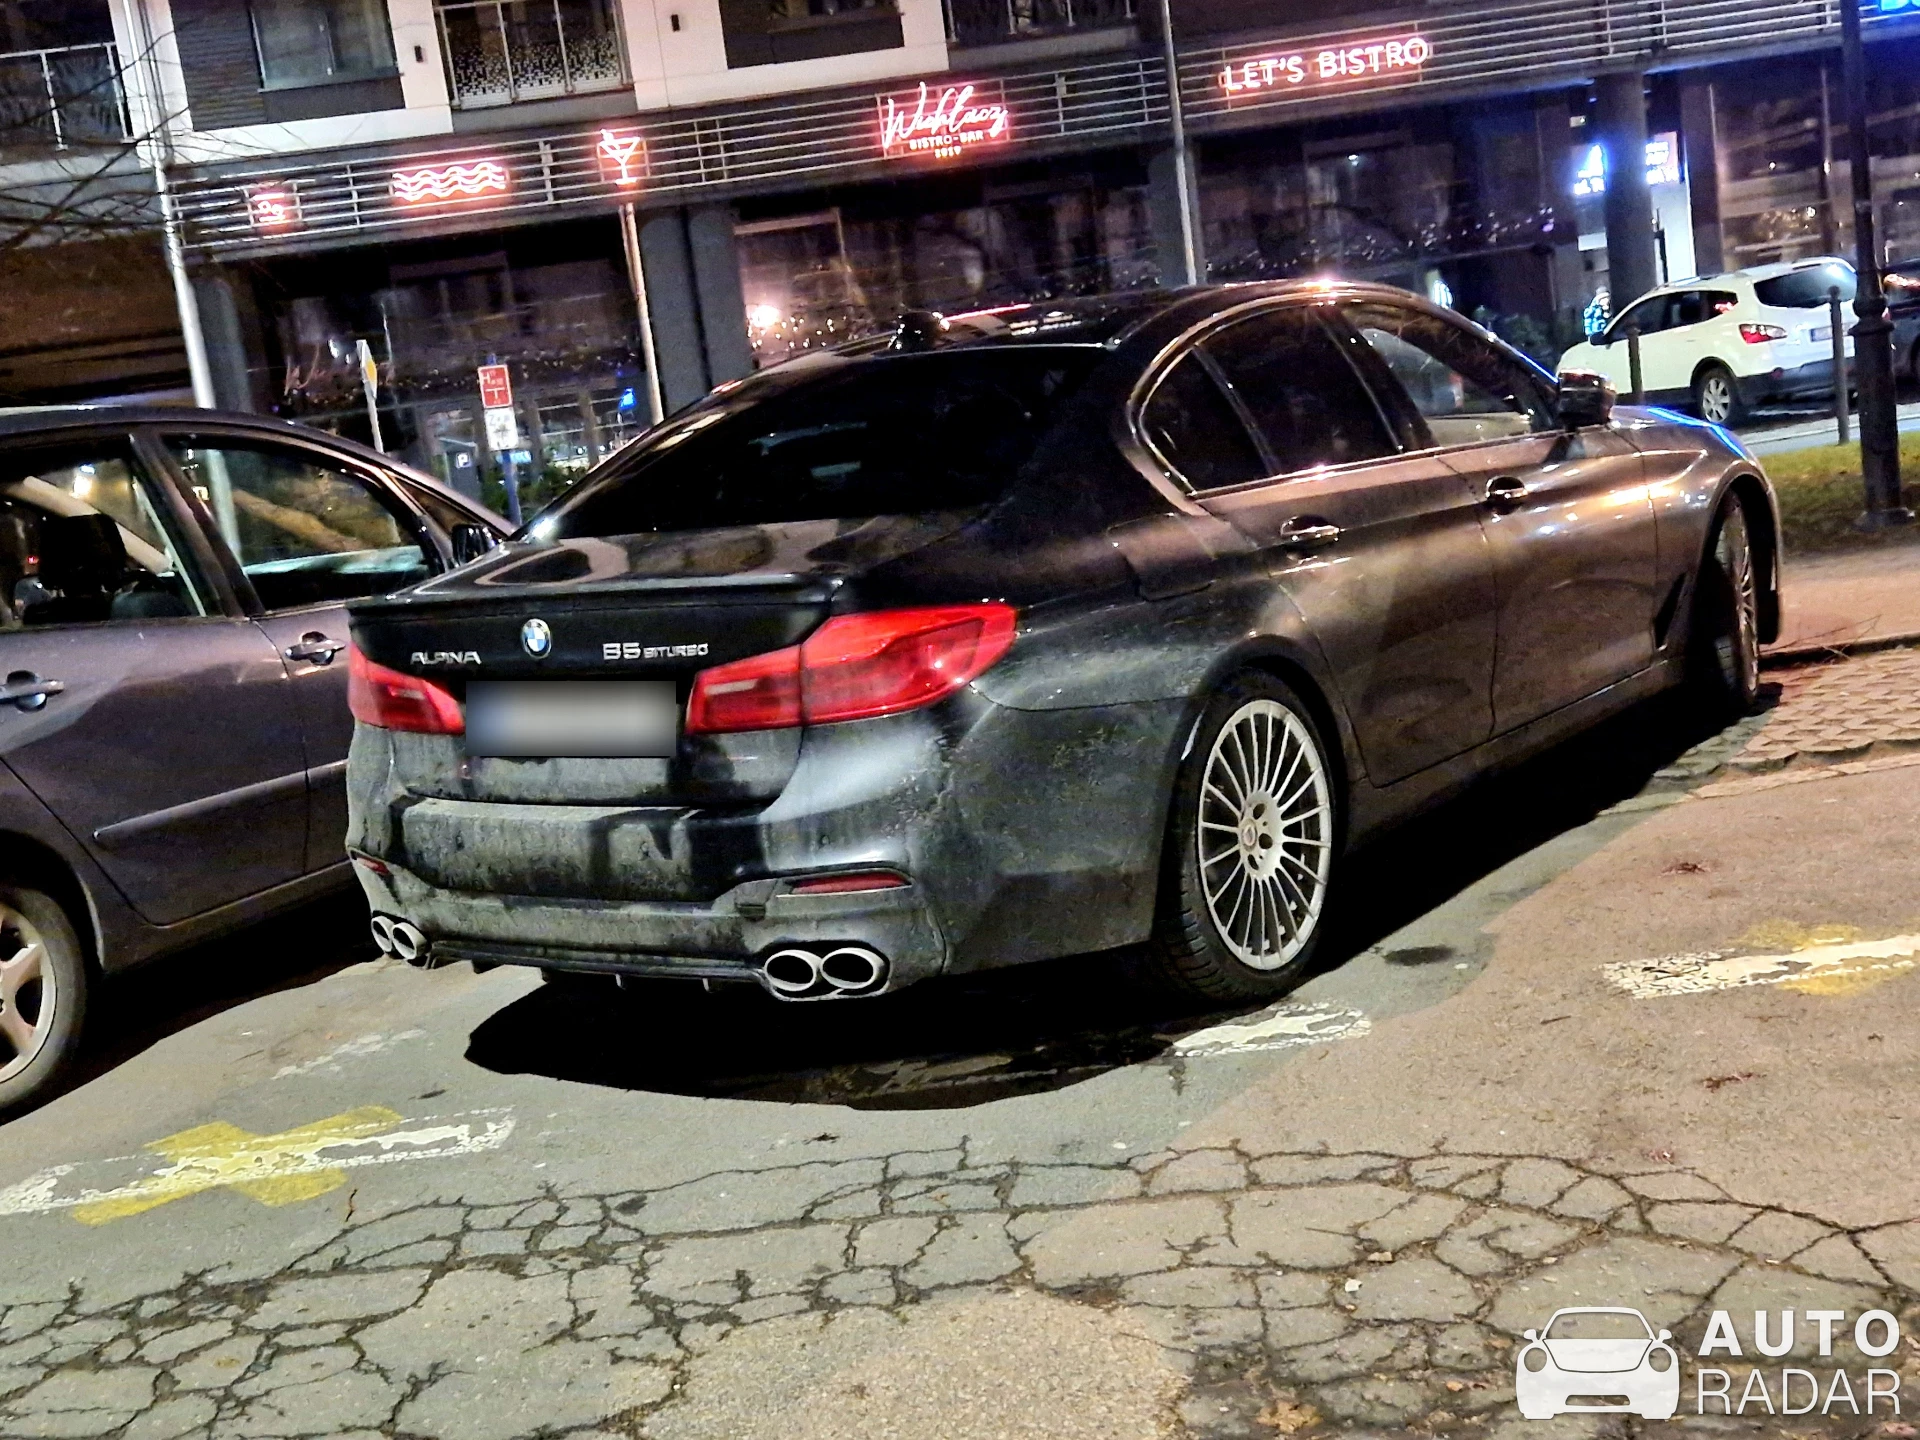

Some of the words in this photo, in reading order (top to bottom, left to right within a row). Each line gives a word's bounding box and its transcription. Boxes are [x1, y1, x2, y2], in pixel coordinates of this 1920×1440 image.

[1224, 55, 1304, 91] LET'S
[1317, 37, 1429, 79] BISTRO
[909, 130, 984, 150] BISTRO-BAR
[410, 650, 482, 665] ALPINA
[602, 642, 641, 660] B5
[643, 643, 709, 658] BITURBO
